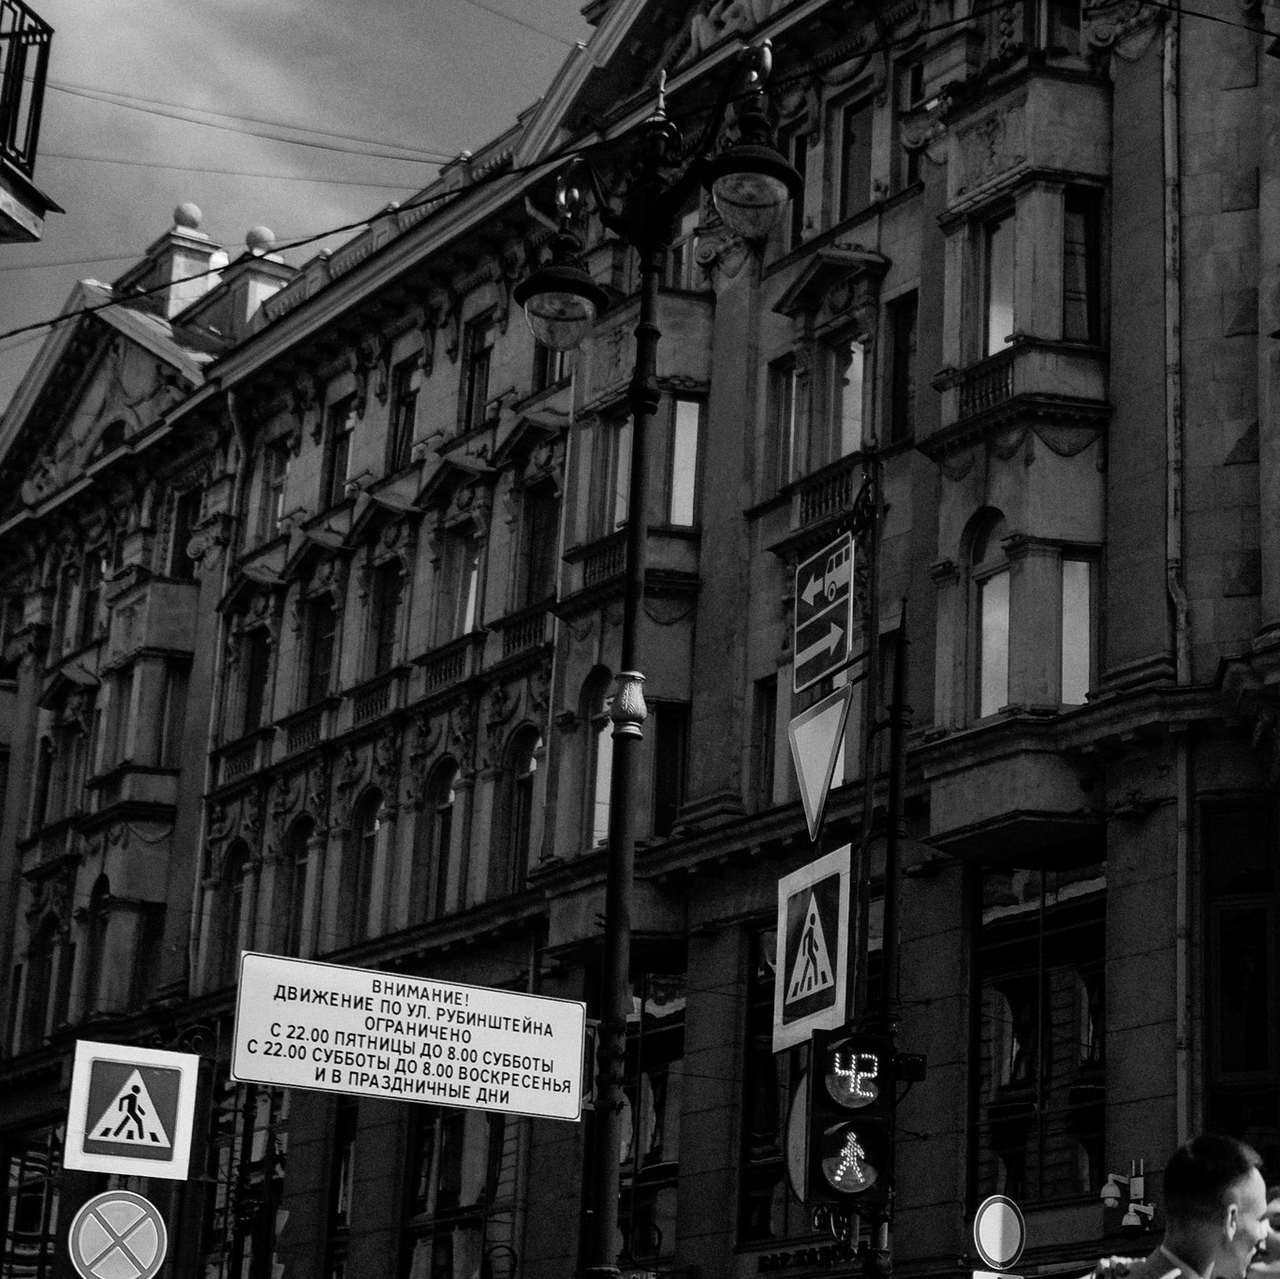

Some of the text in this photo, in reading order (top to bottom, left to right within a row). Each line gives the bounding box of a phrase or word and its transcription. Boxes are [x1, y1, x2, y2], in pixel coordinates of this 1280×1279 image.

[273, 984, 554, 1037] ДВИЖЕНИЕ ПО УЛ. РУБИНШТЕЙНА
[372, 979, 469, 1006] ВНИМАНИЕ!
[270, 1022, 554, 1073] С 22.00 ПЯТНИЦЫ ДО 8.00 СУББОТЫ
[364, 1016, 472, 1044] ОГРАНИЧЕНО
[247, 1039, 571, 1093] С 22.00 СУББОТЫ ДО 8.00 ВОСКРЕСЕНЬЯ
[315, 1067, 510, 1105] И В ПРАЗДНИЧНЫЕ ДНИ
[834, 1052, 878, 1098] 42
